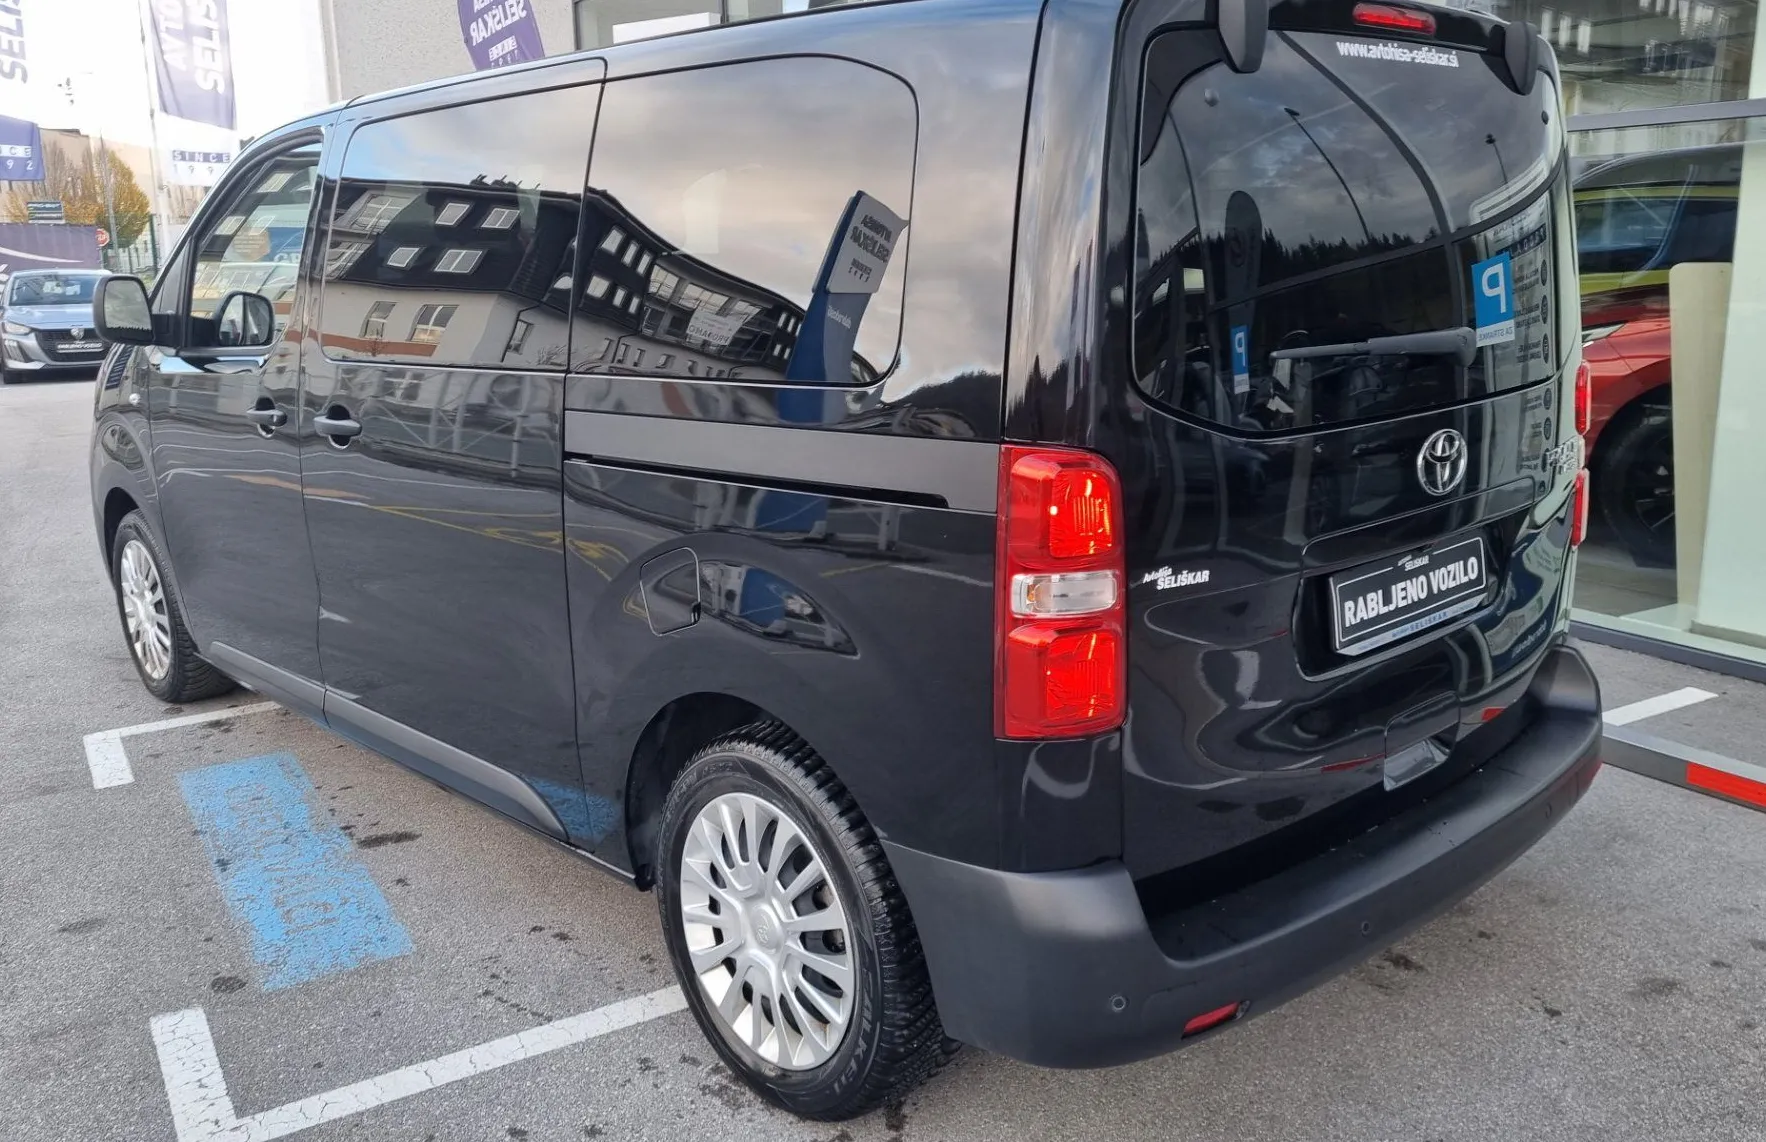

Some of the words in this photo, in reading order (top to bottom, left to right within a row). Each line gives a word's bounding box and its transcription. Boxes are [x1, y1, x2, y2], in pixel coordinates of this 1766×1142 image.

[0, 0, 28, 84] SELI
[174, 151, 230, 162] SINCE
[1156, 570, 1210, 590] SELIŠKAR
[1344, 575, 1428, 627] RABLJENO
[1429, 556, 1478, 594] VOZILO
